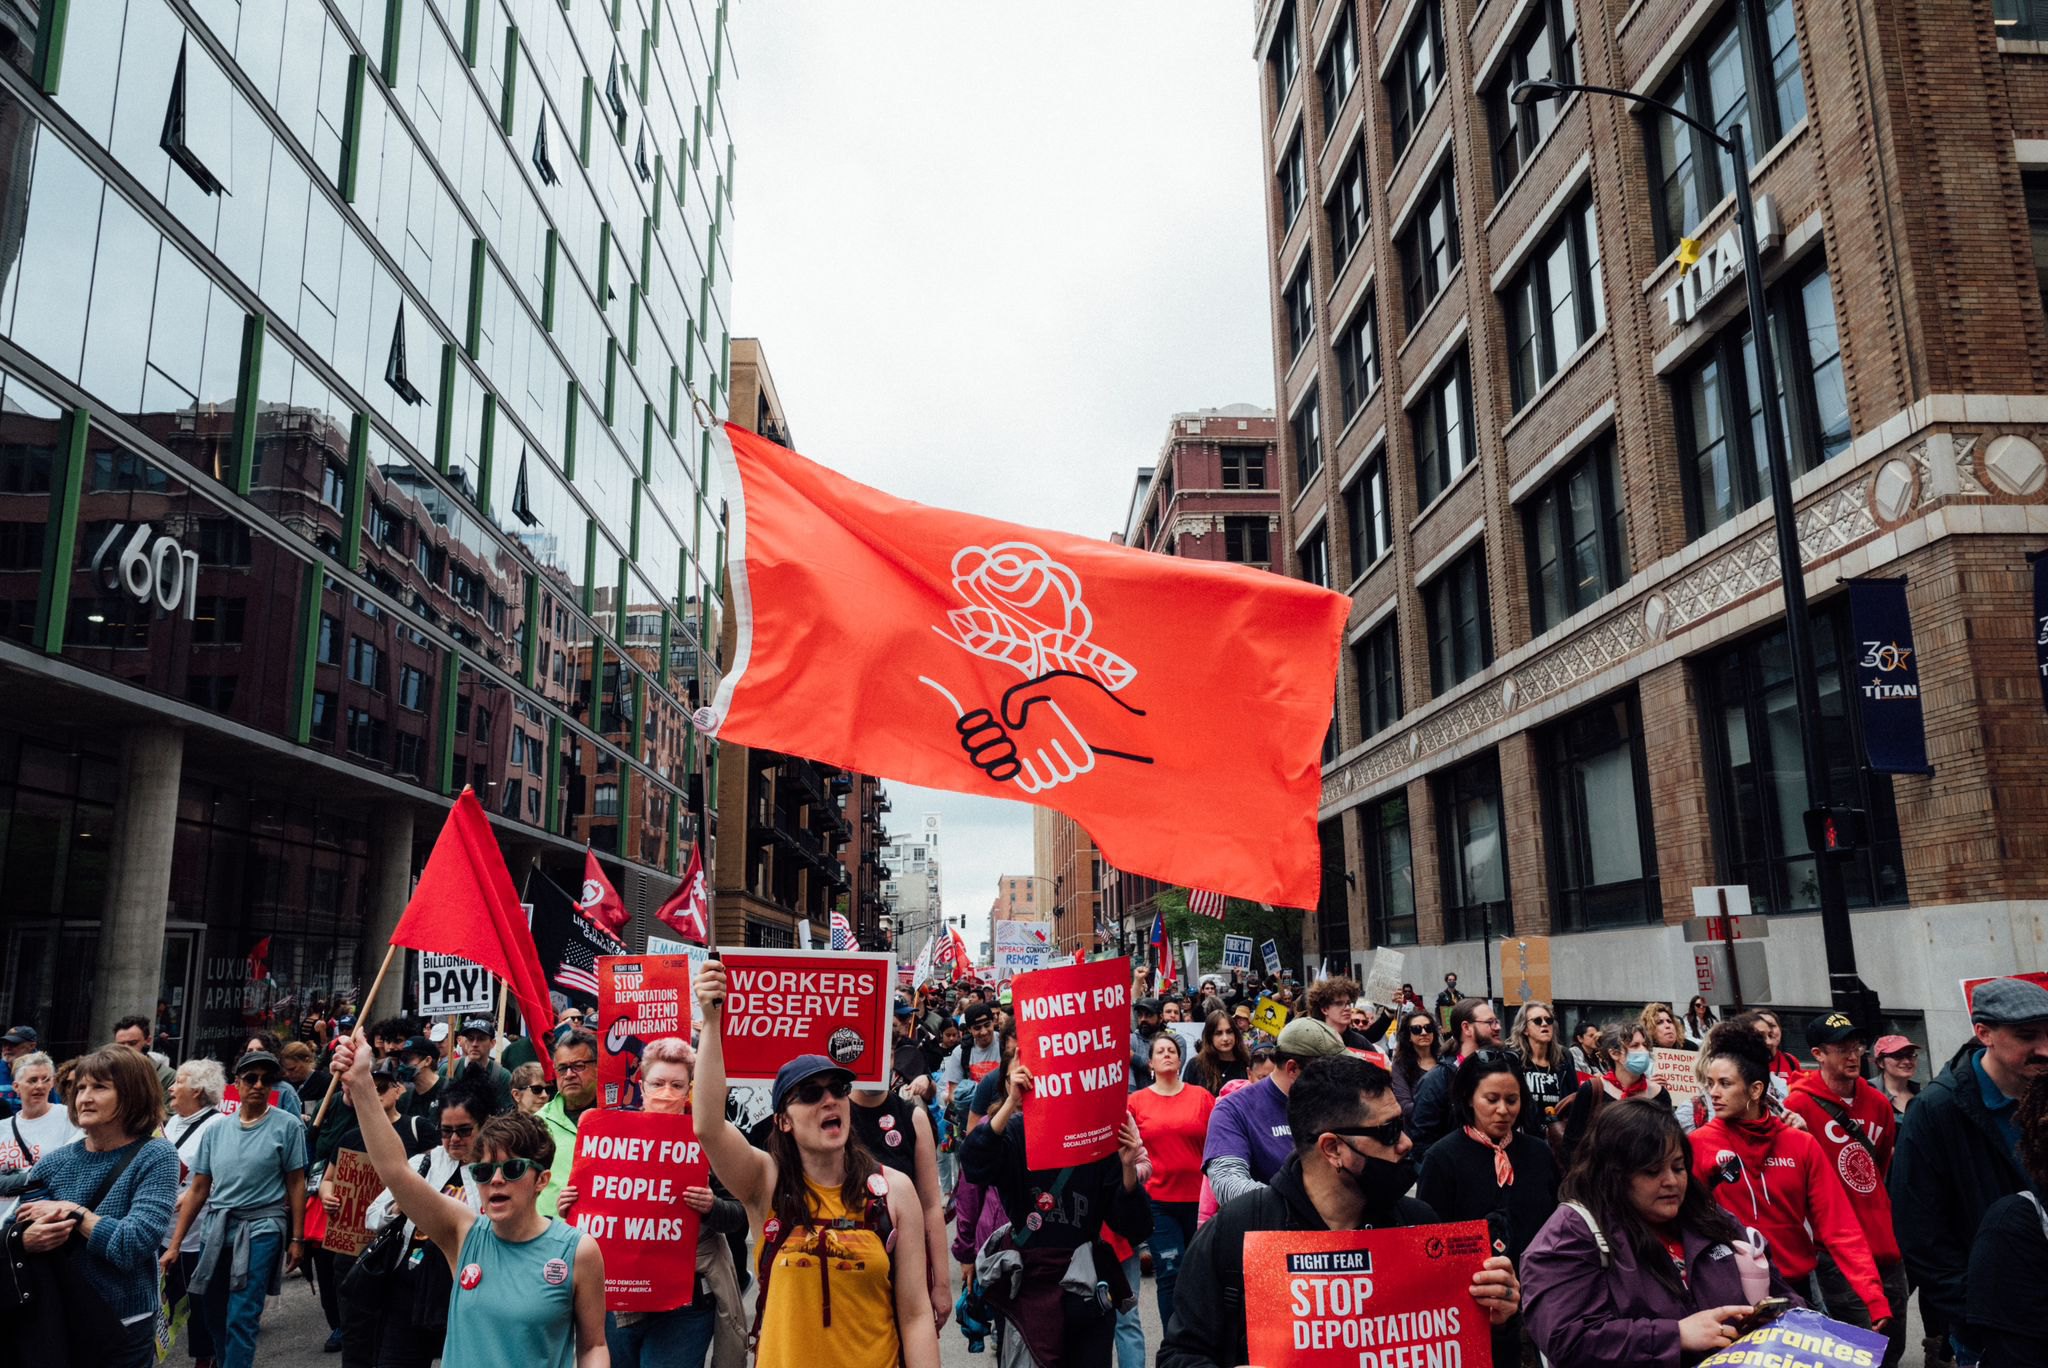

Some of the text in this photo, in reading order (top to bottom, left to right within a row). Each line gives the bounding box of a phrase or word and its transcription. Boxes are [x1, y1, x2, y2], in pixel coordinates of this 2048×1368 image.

[1695, 270, 1735, 311] SECURITY
[119, 523, 199, 621] 601
[1860, 641, 1898, 671] 30
[1862, 684, 1918, 700] TITAN
[573, 913, 590, 932] LIKE
[1706, 915, 1741, 940] HC
[207, 957, 262, 981] LUXURY
[1006, 954, 1039, 966] REMOVE
[423, 968, 489, 1005] PAY!
[614, 974, 643, 990] STOP
[730, 970, 875, 995] WORKERS
[615, 989, 678, 1004] DEPORTATIONS
[727, 993, 860, 1017] DESERVE
[1020, 983, 1125, 1022] MONEY FOR
[638, 1002, 678, 1019] DEFEND
[615, 1019, 678, 1036] IMMIGRANTS
[726, 1016, 813, 1038] MORE
[1038, 1025, 1117, 1058] PEOPLE,
[1672, 1064, 1690, 1072] FOR
[1034, 1060, 1123, 1099] NOT WARS
[1661, 1073, 1694, 1083] USTICE
[1063, 1138, 1091, 1148] SOCIALISTS
[1064, 1132, 1087, 1141] CHICAGO
[341, 1151, 358, 1161] THE
[581, 1135, 700, 1164] MONEY FOR
[363, 1163, 376, 1172] WA
[1764, 1157, 1796, 1168] SING
[334, 1184, 341, 1195] IS
[342, 1186, 352, 1197] BY
[591, 1175, 678, 1205] PEOPLE,
[327, 1229, 353, 1240] GRACE
[576, 1213, 683, 1241] NOT WARS
[324, 1239, 356, 1252] BOGGS
[1293, 1252, 1363, 1270] FIGHT FEAR
[1290, 1278, 1373, 1317] STOP
[1293, 1307, 1461, 1350] DEPORTATIONS
